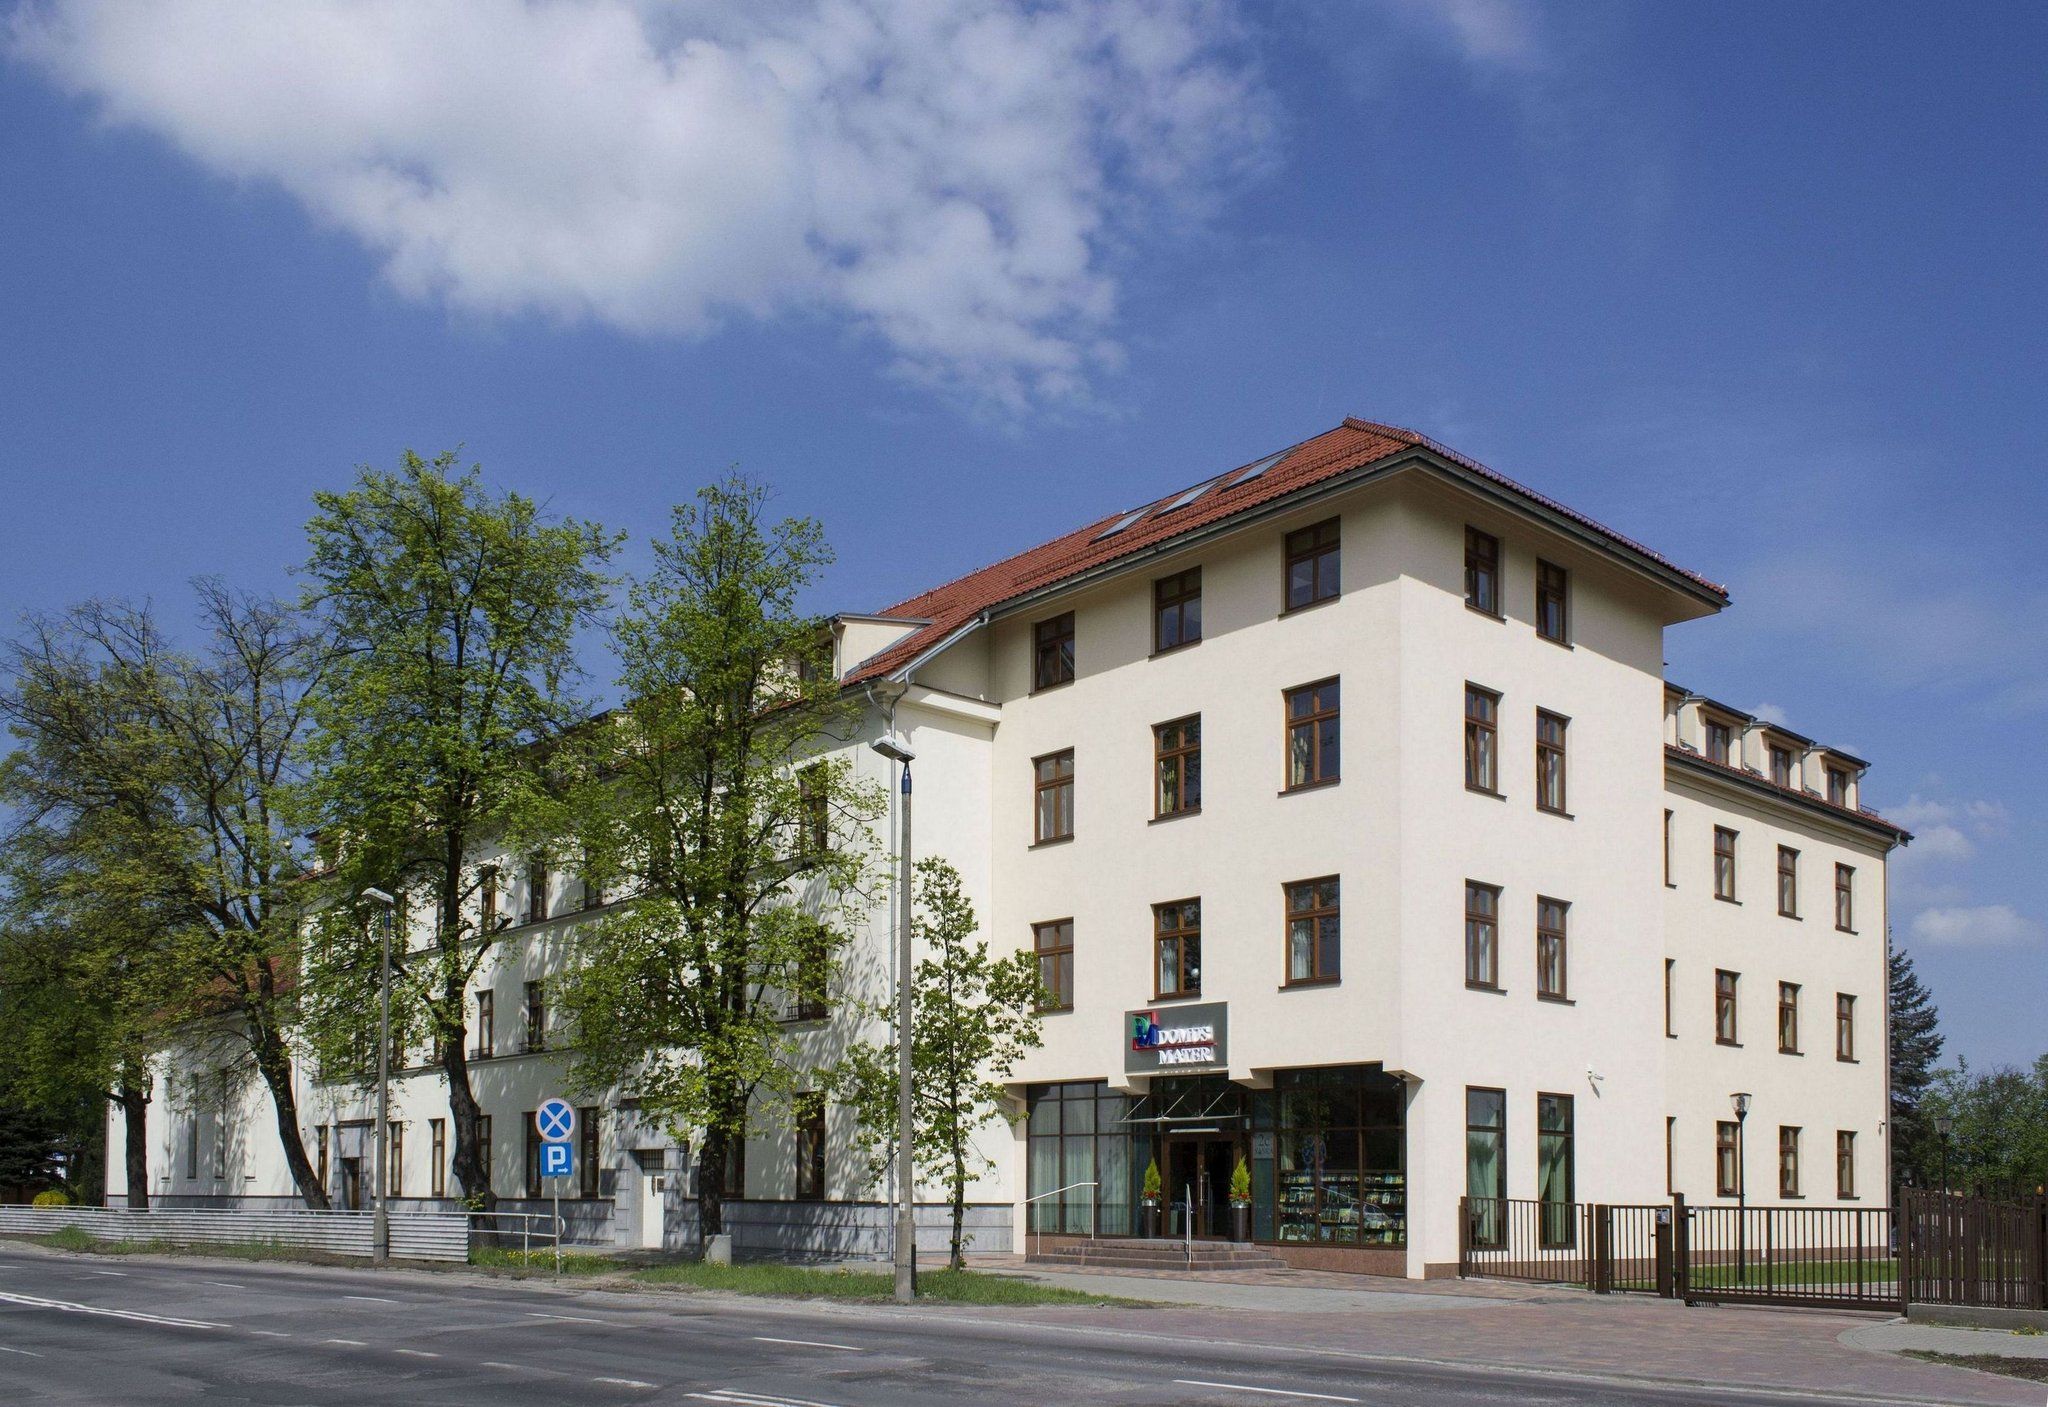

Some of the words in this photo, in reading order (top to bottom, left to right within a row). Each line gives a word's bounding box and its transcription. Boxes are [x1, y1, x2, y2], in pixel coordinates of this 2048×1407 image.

[1157, 1026, 1213, 1046] DOMUS
[1158, 1046, 1214, 1065] MATER
[547, 1146, 566, 1173] P
